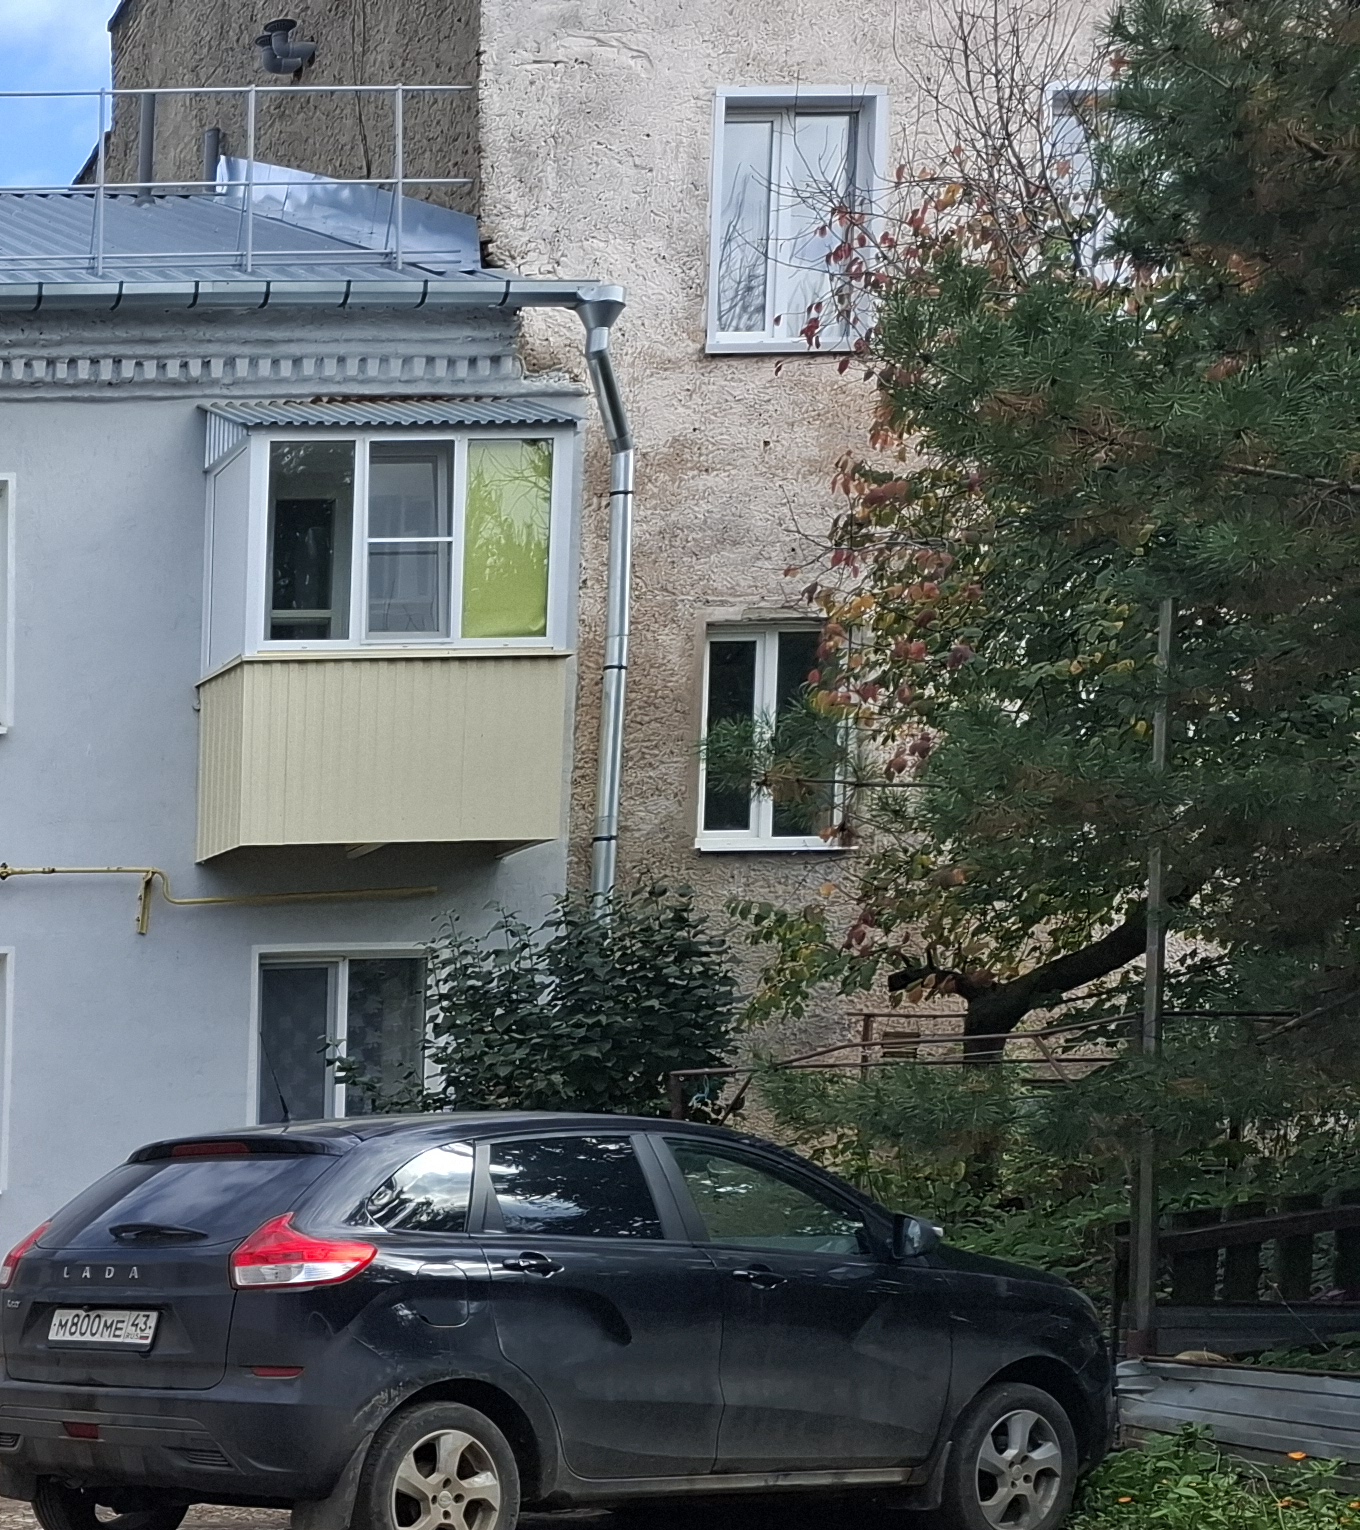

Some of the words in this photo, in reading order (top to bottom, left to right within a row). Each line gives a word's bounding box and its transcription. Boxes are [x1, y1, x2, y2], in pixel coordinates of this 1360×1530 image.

[63, 1266, 139, 1279] LADA
[55, 1313, 126, 1339] М800МЕ
[130, 1313, 151, 1333] 43
